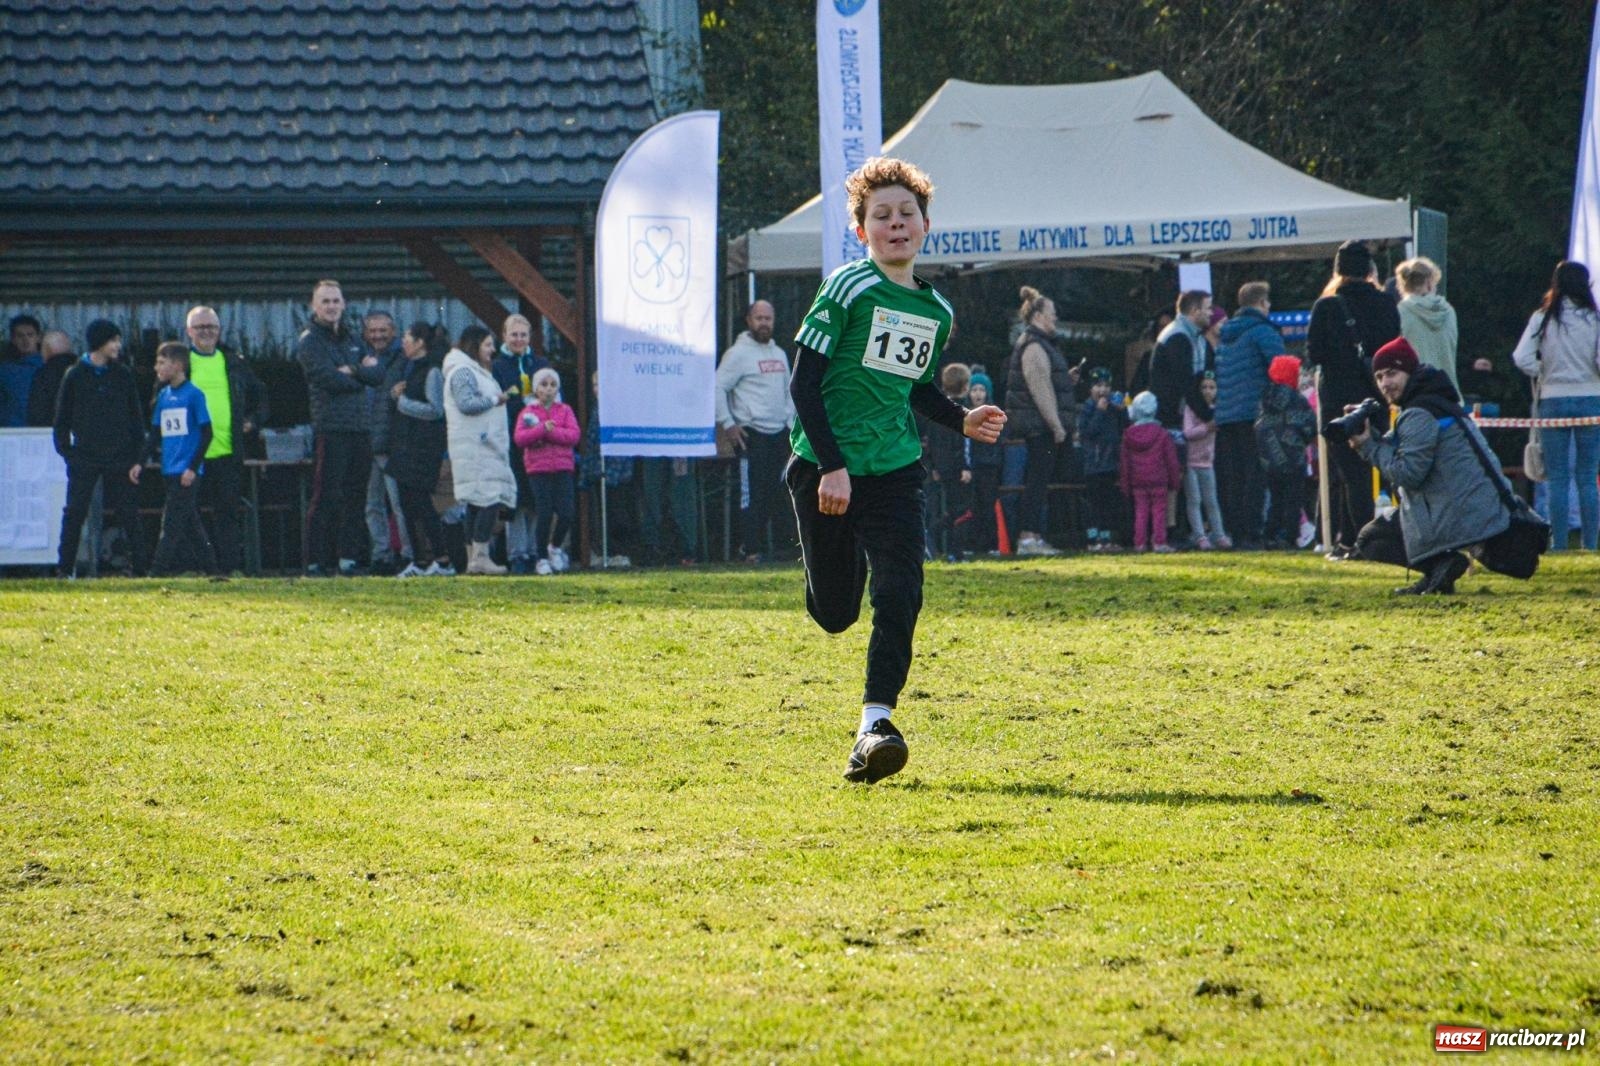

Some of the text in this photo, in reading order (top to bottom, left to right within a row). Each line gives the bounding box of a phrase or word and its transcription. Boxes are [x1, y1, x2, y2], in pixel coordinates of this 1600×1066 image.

[919, 216, 1299, 254] ZYSZENIE AKTYWNI DLA LEPSZEGO JUTRA
[621, 342, 695, 356] PIETROWICE
[874, 331, 931, 369] 138
[633, 363, 683, 376] WIELKIE
